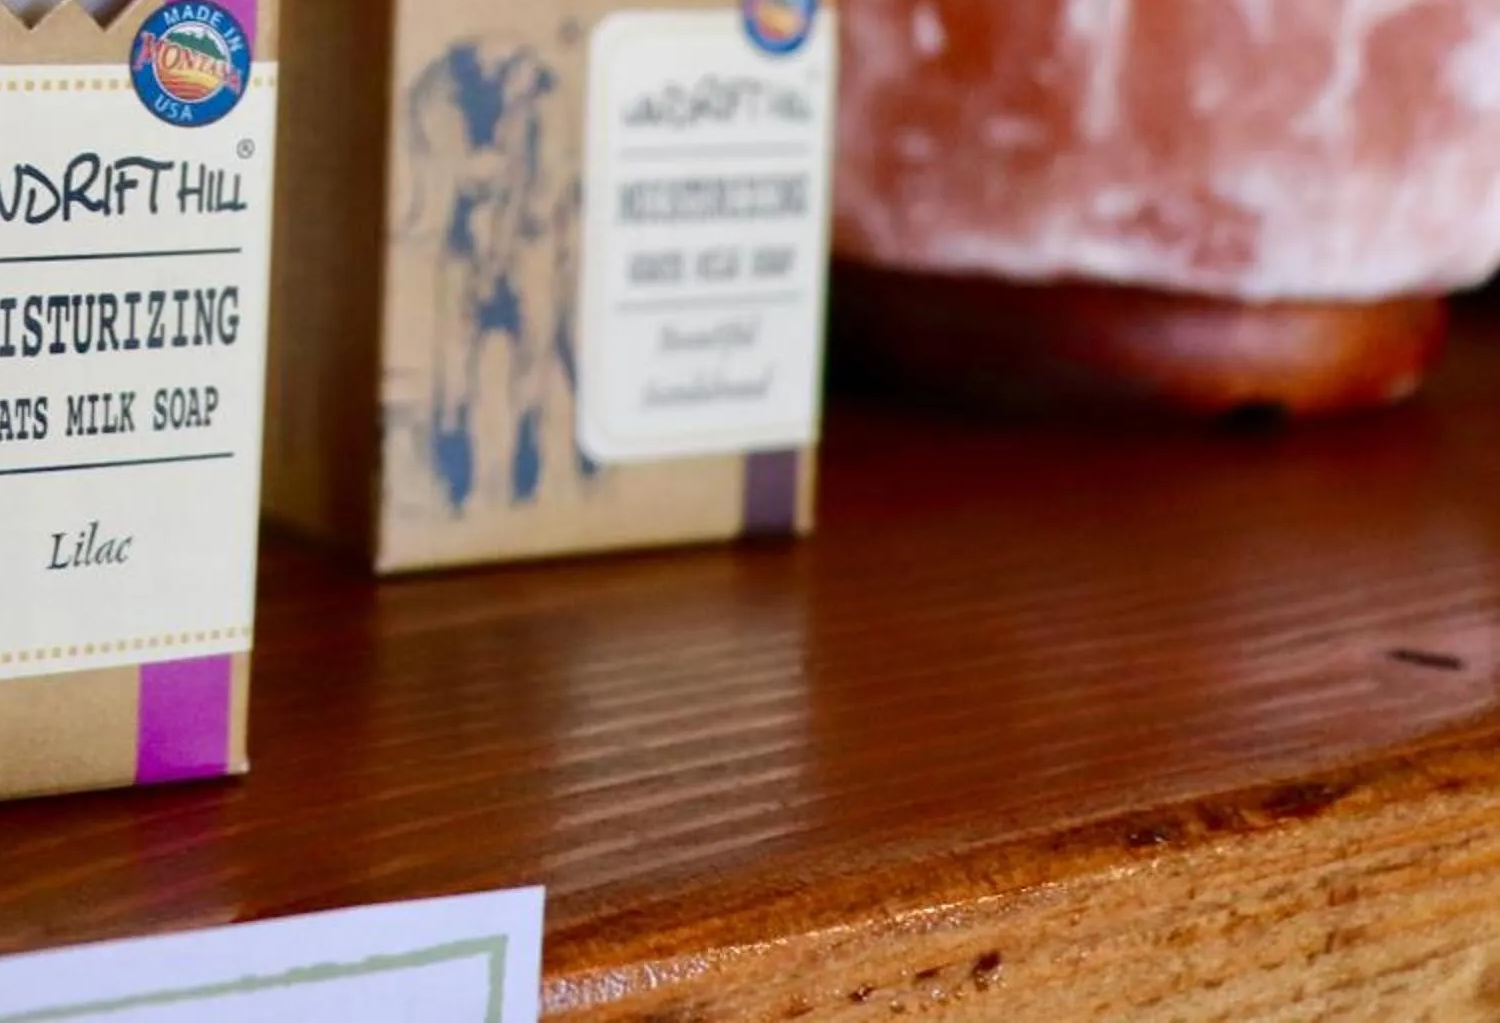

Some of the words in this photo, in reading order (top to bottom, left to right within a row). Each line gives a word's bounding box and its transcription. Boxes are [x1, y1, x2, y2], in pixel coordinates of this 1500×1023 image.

[164, 4, 224, 27] MADE
[224, 26, 244, 52] IN
[154, 94, 193, 121] USA
[177, 161, 247, 213] HILL
[66, 391, 136, 436] MILK
[152, 385, 219, 431] SOAP
[46, 520, 132, 570] Lilac
